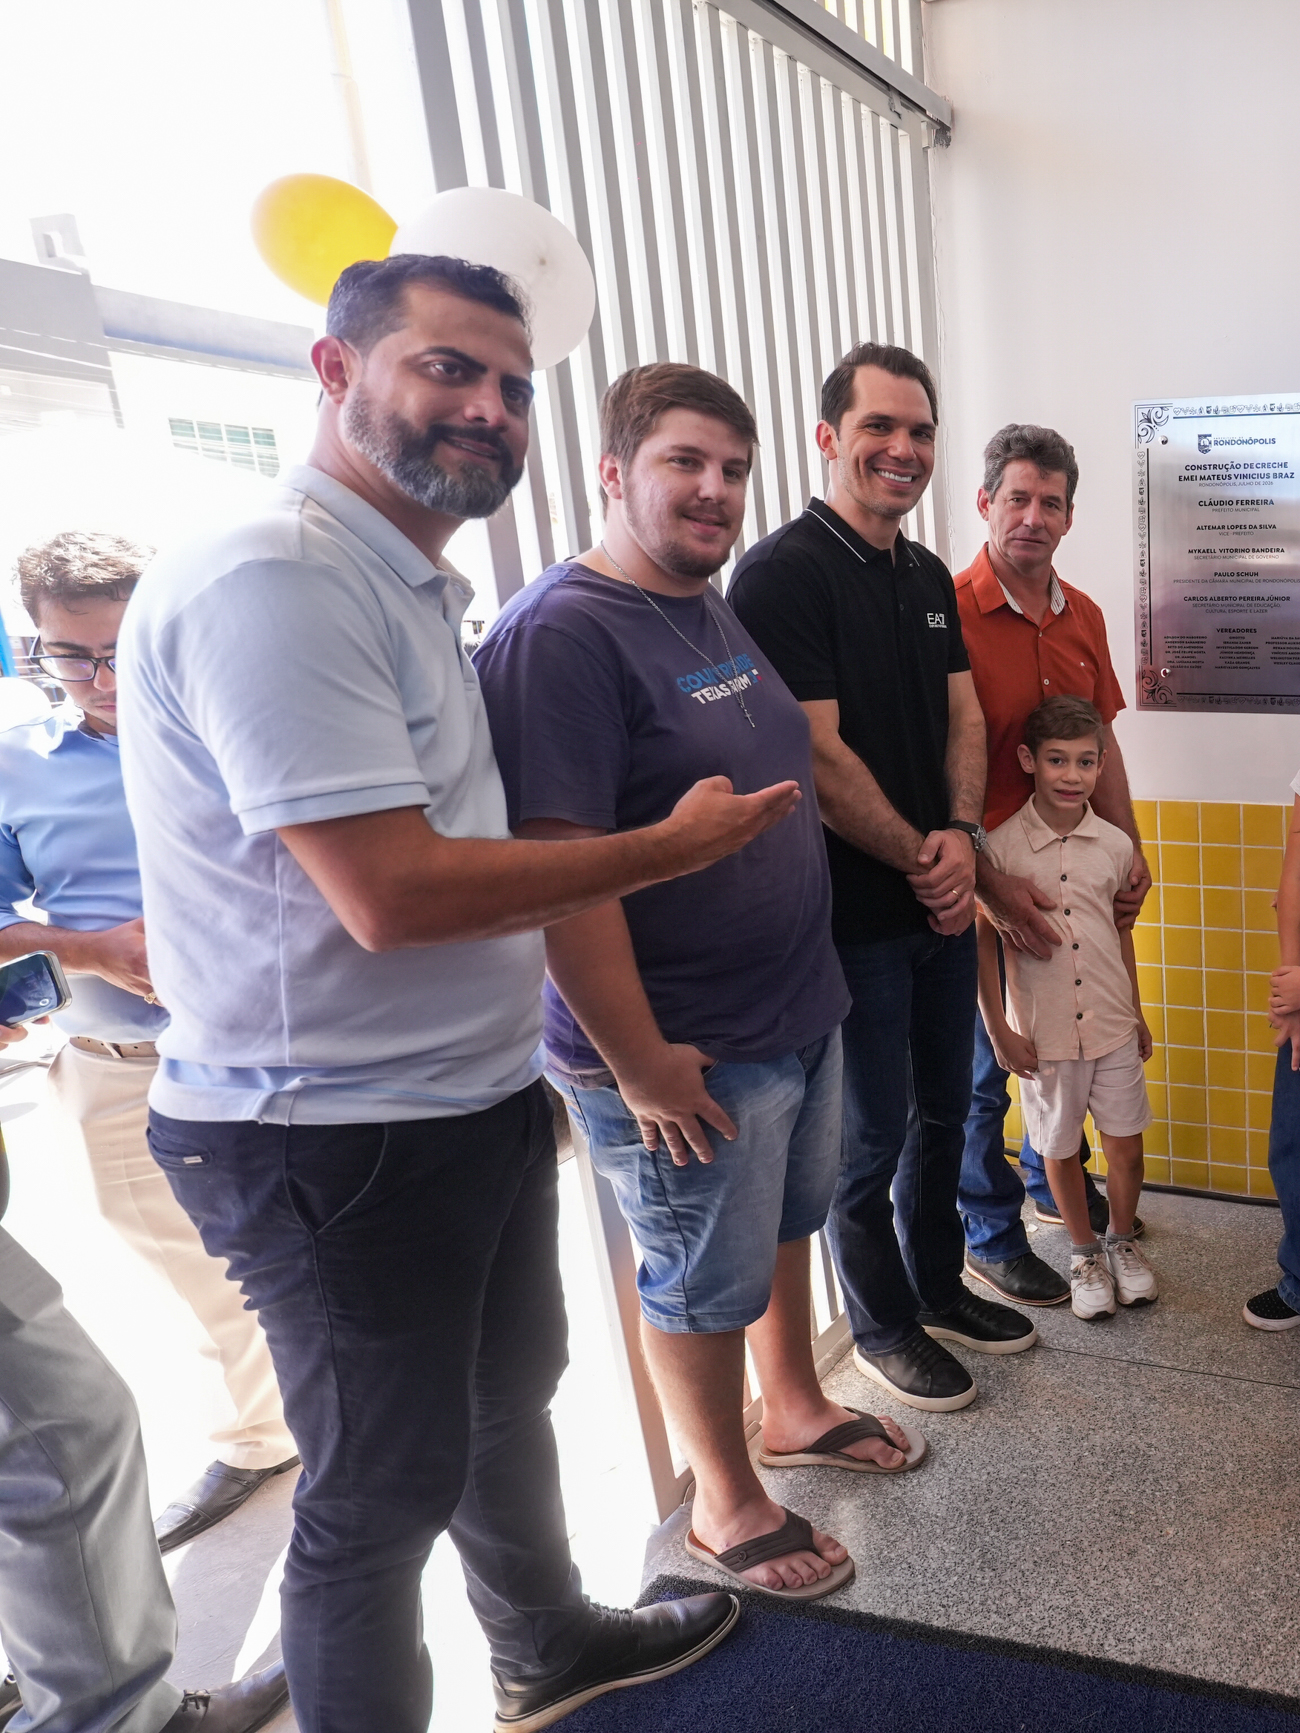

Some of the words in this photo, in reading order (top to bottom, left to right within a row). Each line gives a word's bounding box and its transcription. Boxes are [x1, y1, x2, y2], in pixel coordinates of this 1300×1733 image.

[1213, 437, 1276, 446] RONDONÓPOLIS
[1185, 461, 1241, 472] CONSTRUÇÃO
[1198, 498, 1234, 507] CLÁUDIO
[1266, 594, 1291, 602] JÚNIOR
[927, 613, 944, 624] EA7
[691, 683, 732, 705] TEXAS
